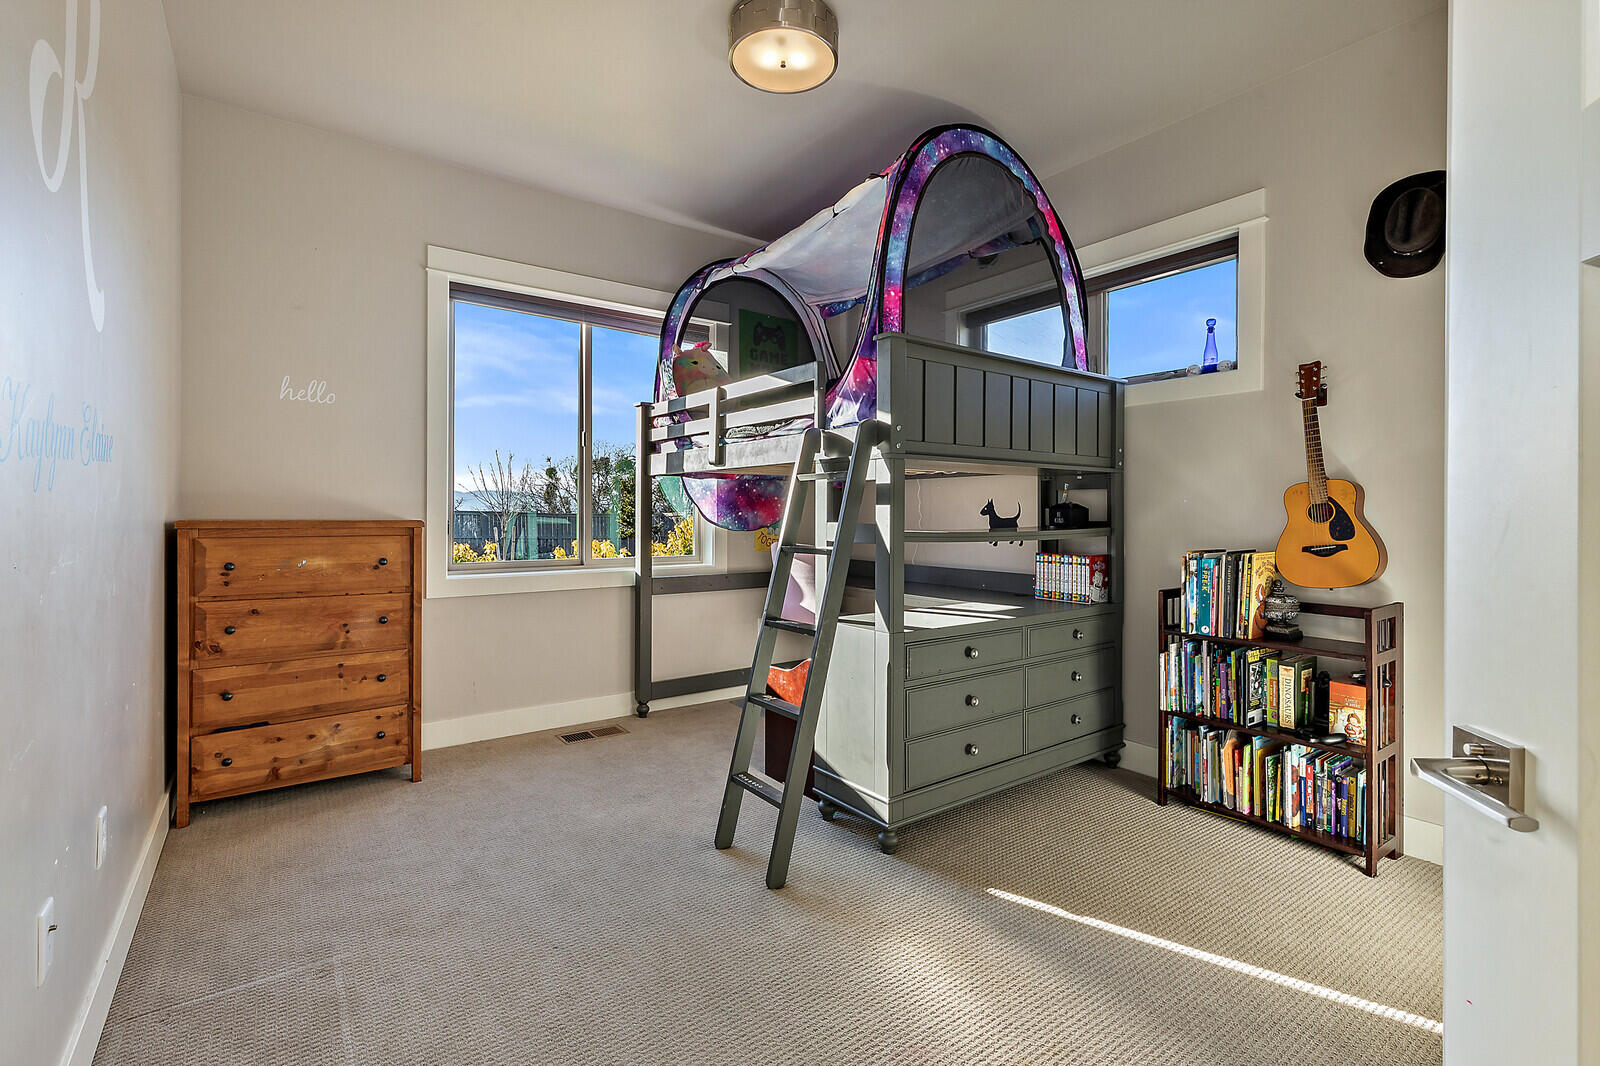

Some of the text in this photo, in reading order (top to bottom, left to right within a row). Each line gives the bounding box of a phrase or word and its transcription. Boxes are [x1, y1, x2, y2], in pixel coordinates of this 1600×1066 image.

[750, 348, 789, 365] GAME
[279, 375, 337, 405] hello
[0, 376, 114, 492] Kaylynn Elaine
